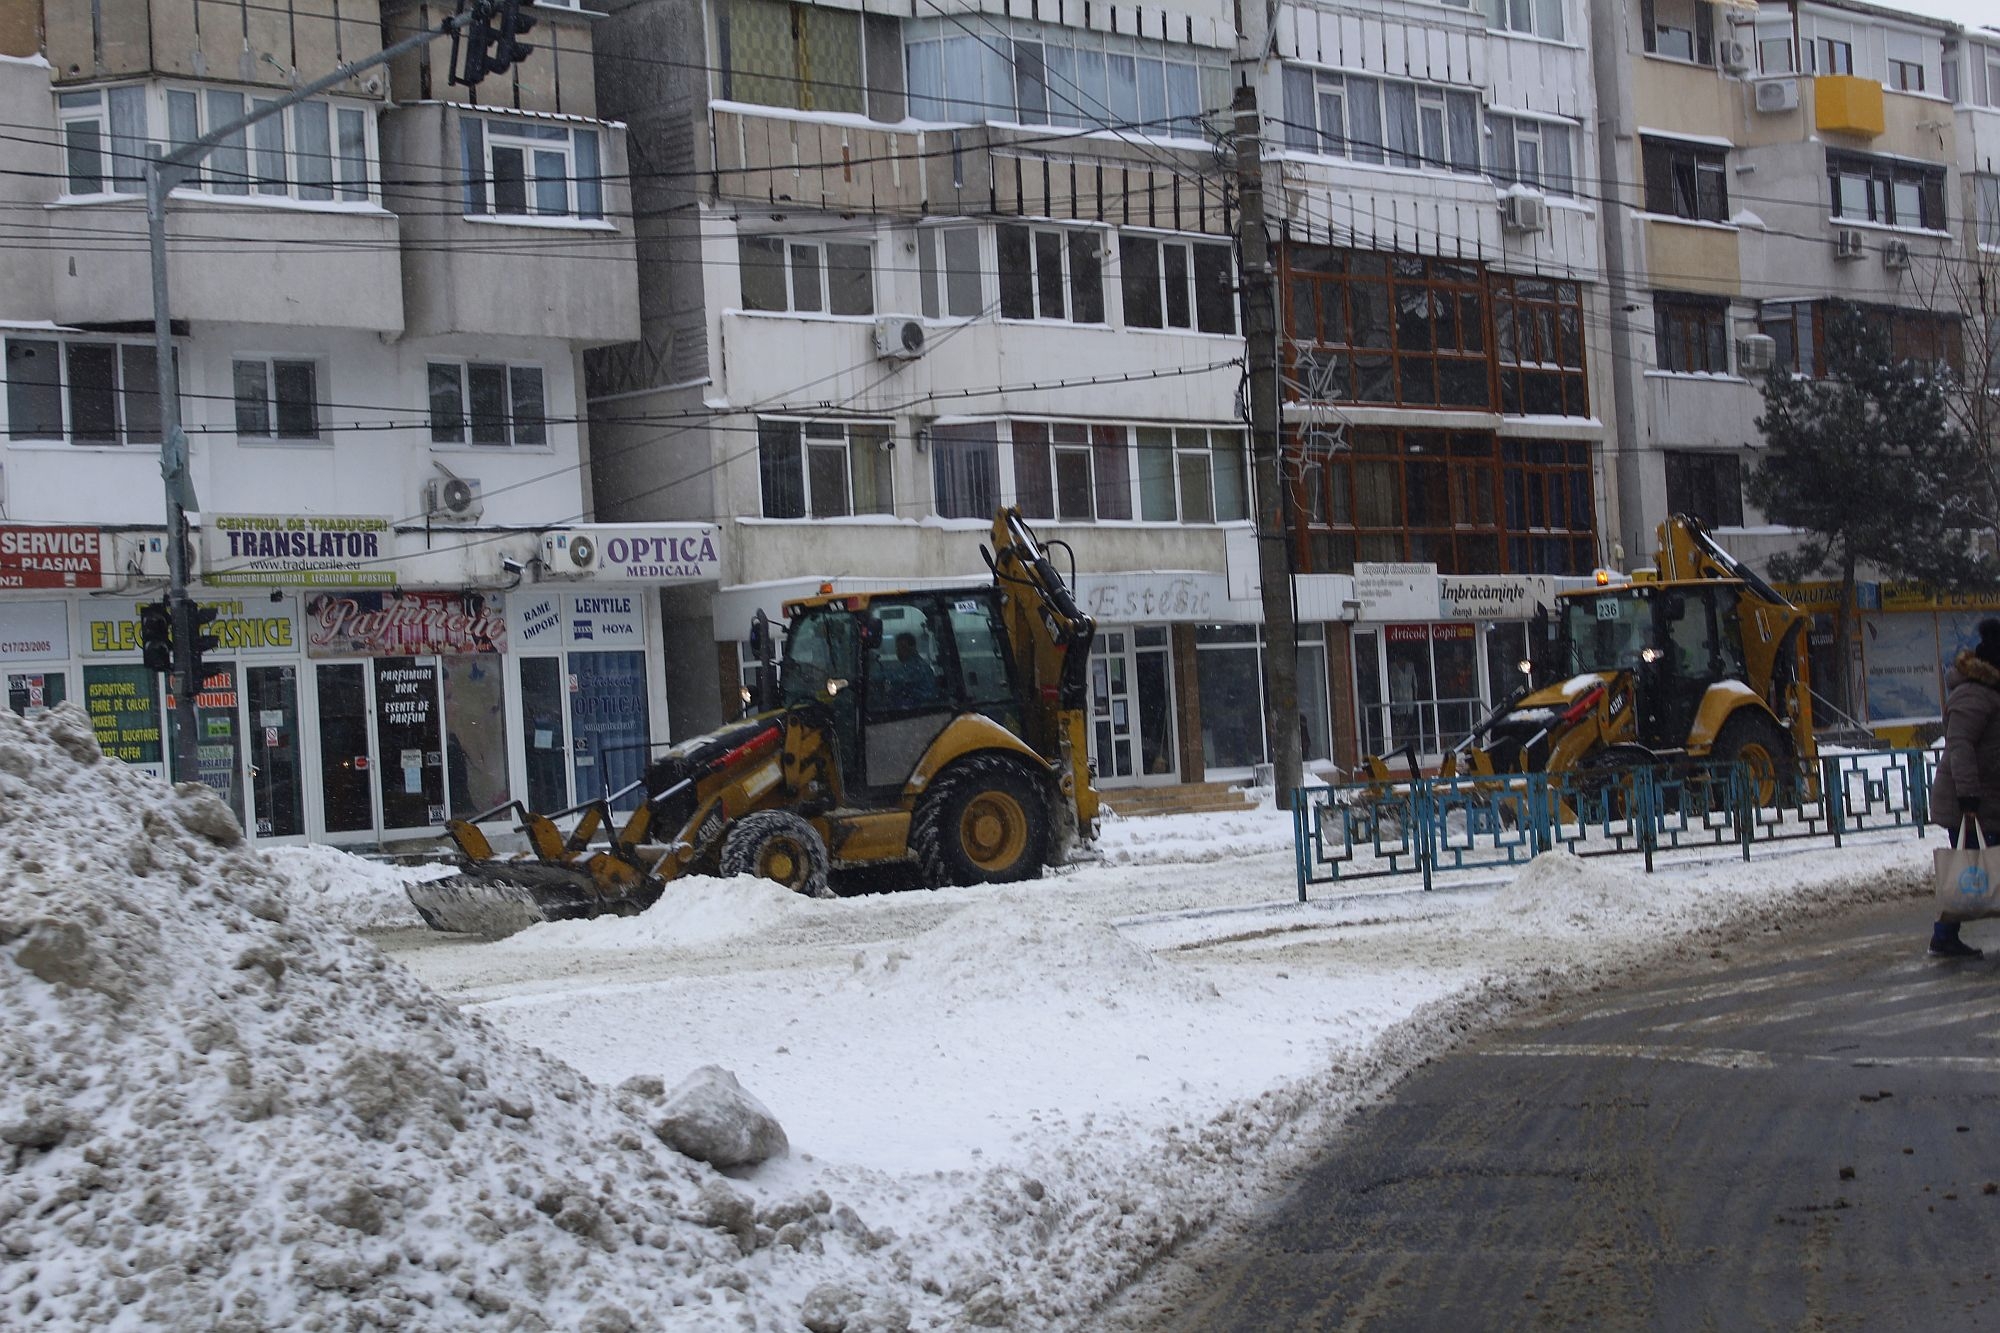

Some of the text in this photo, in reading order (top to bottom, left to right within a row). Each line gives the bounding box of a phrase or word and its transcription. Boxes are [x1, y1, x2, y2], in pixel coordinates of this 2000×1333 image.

[216, 517, 388, 532] CENTRUL DE TRADUCERI
[1, 532, 98, 554] SERVICE
[227, 531, 378, 557] TRANSLATOR
[607, 530, 718, 564] OPTICĂ
[22, 557, 92, 571] PLASMA
[250, 559, 360, 570] www.traducerile.eu
[626, 562, 702, 577] MEDICALĂ
[523, 602, 551, 622] RAME
[575, 598, 631, 613] LENTILE
[1599, 603, 1617, 617] 236
[312, 596, 506, 645] Parfumerie
[523, 612, 560, 640] IMPORT
[602, 624, 633, 634] HOYA
[1391, 626, 1427, 641] Articole
[1433, 626, 1457, 641] Copii
[381, 669, 432, 683] PARFUMURI
[89, 683, 136, 697] ASPIRATOARE
[394, 683, 418, 694] VRAC
[92, 698, 151, 712] FIARE DE CALCAT
[385, 701, 429, 713] ESENTE DE
[92, 715, 117, 727] MIXERE
[390, 713, 426, 725] PARFUM
[123, 728, 159, 742] BUCATARIE
[119, 746, 141, 759] CAFEA
